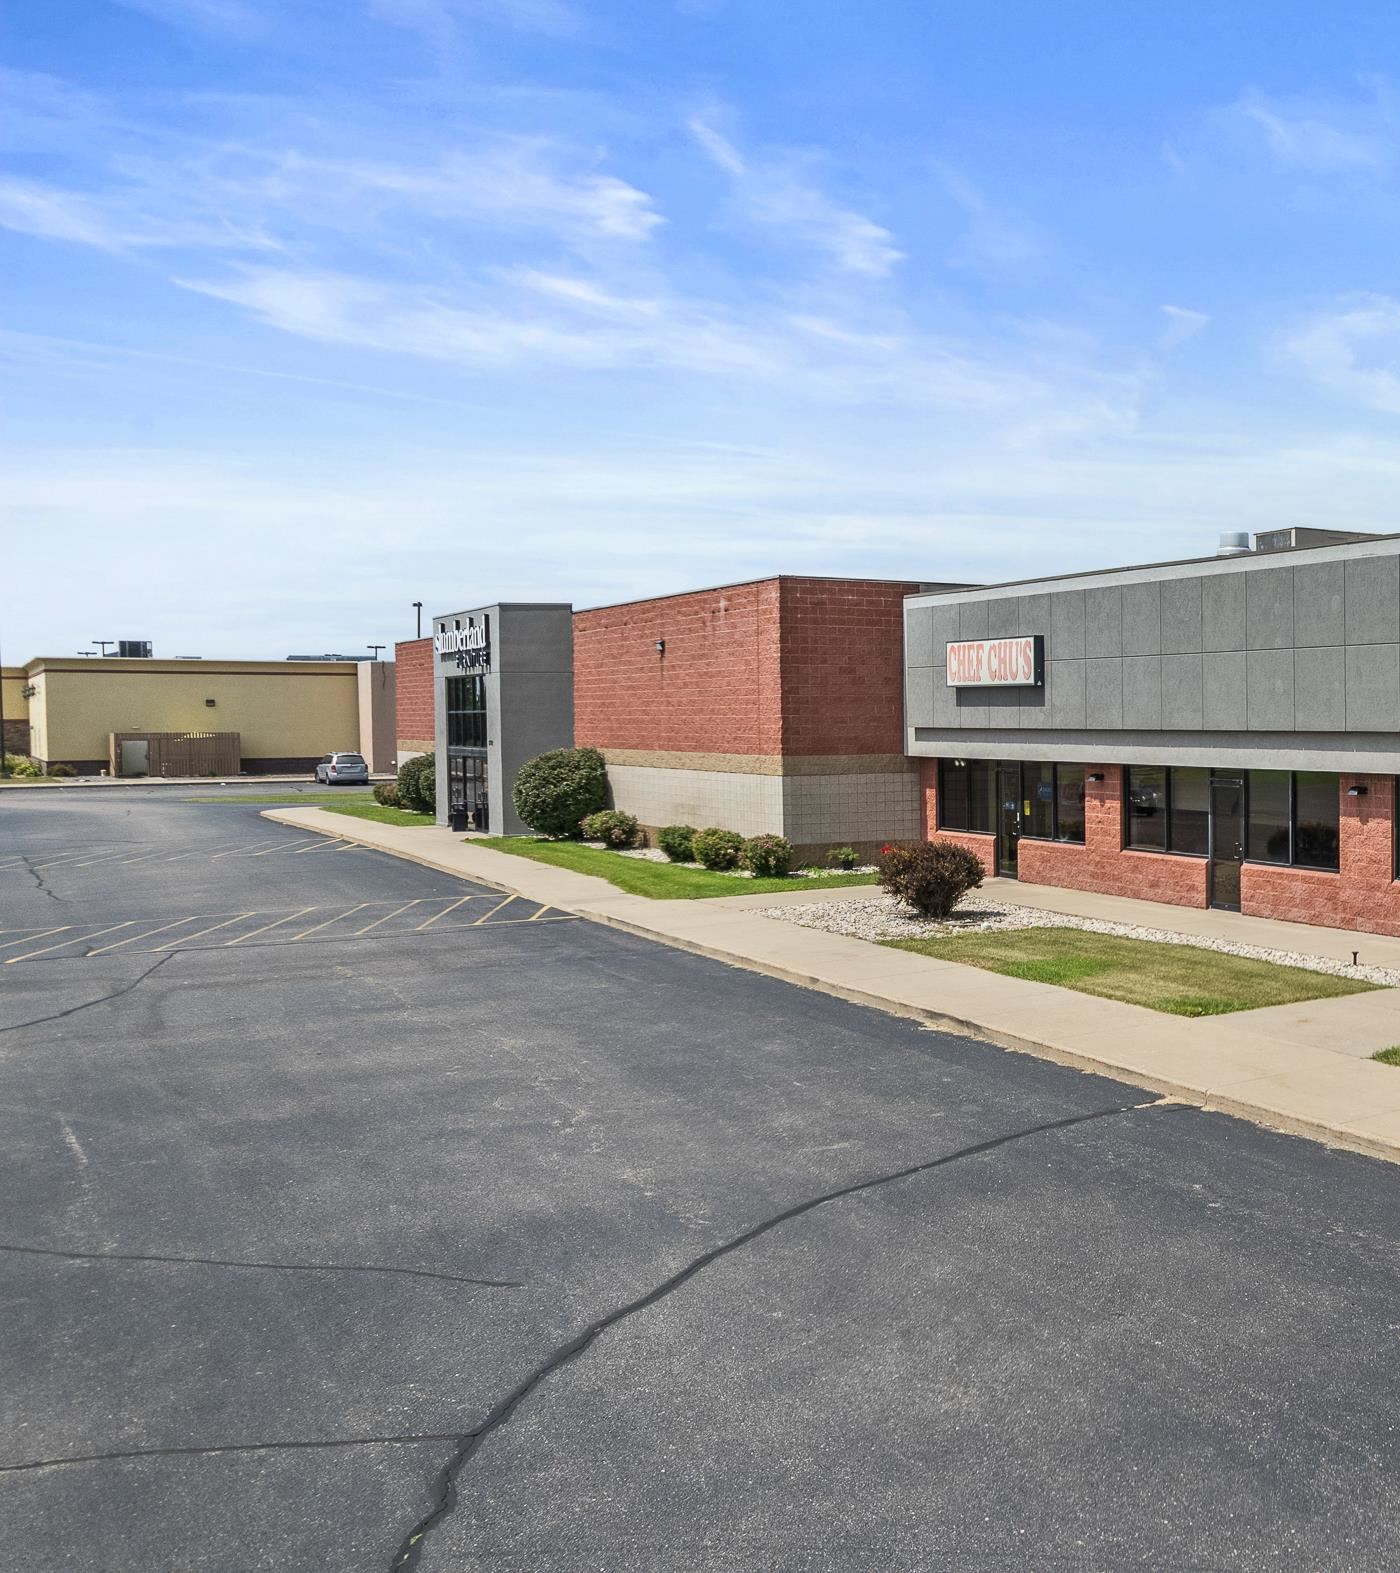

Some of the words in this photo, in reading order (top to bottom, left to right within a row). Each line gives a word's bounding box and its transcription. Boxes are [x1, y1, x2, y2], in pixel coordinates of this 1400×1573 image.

[435, 614, 486, 654] slumberland
[948, 643, 985, 682] CHEF
[987, 640, 1032, 682] CHU'S
